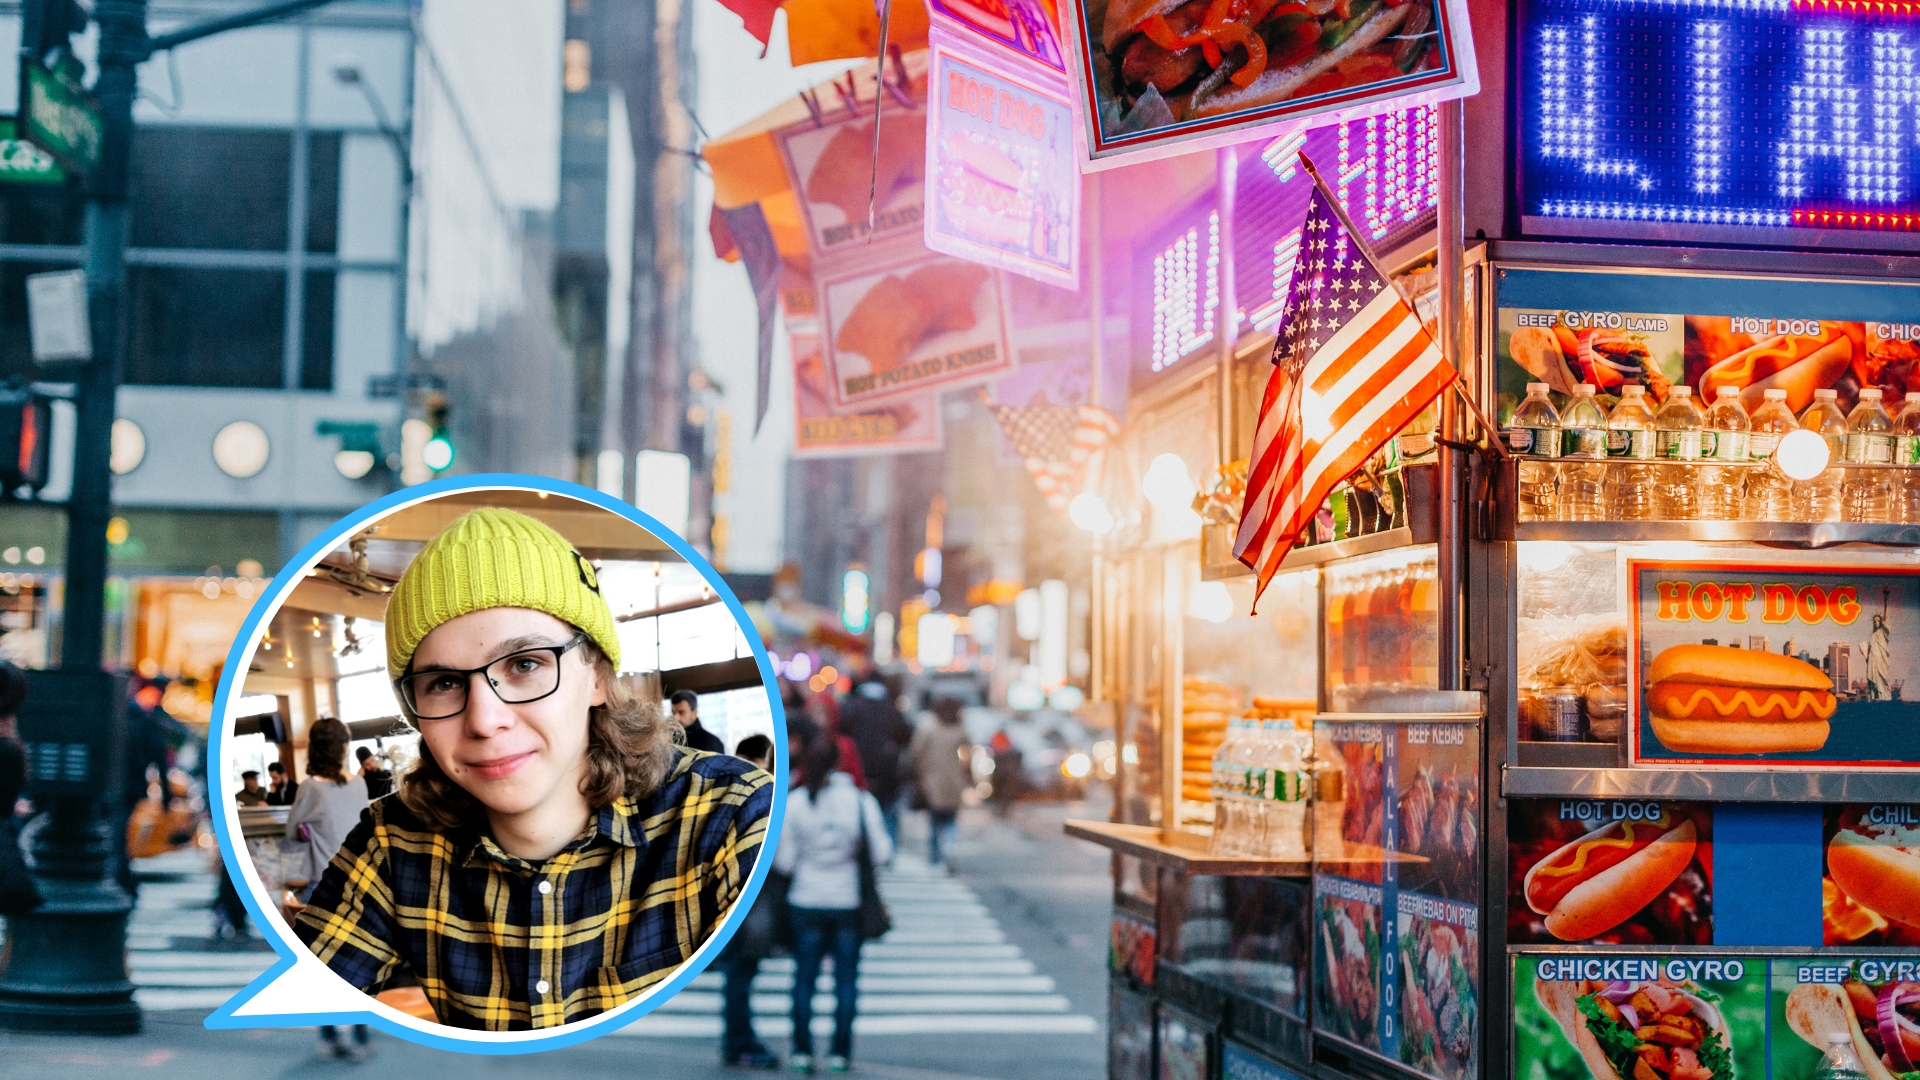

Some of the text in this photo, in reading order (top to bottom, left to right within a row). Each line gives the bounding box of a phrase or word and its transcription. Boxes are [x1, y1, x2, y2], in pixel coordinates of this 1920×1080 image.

[948, 70, 1045, 140] HOT DOG
[859, 206, 920, 236] POTATO
[1518, 311, 1668, 331] BEEF GYRO LAMB
[1731, 317, 1820, 336] HOT DOG
[1877, 322, 1920, 340] CHIC
[880, 357, 942, 386] POTATO
[946, 344, 996, 370] KNISH
[1655, 581, 1862, 626] HOT DOG
[1408, 724, 1464, 745] BEEF KEBAB
[1560, 801, 1661, 821] HOT DOG
[1869, 804, 1920, 824] CHIL
[1385, 734, 1394, 1038] HALAL FOOD
[1398, 892, 1477, 930] BEEF KEBAB ON PITA
[1537, 959, 1745, 982] CHICKEN GYRO
[1798, 966, 1850, 983] BEEF
